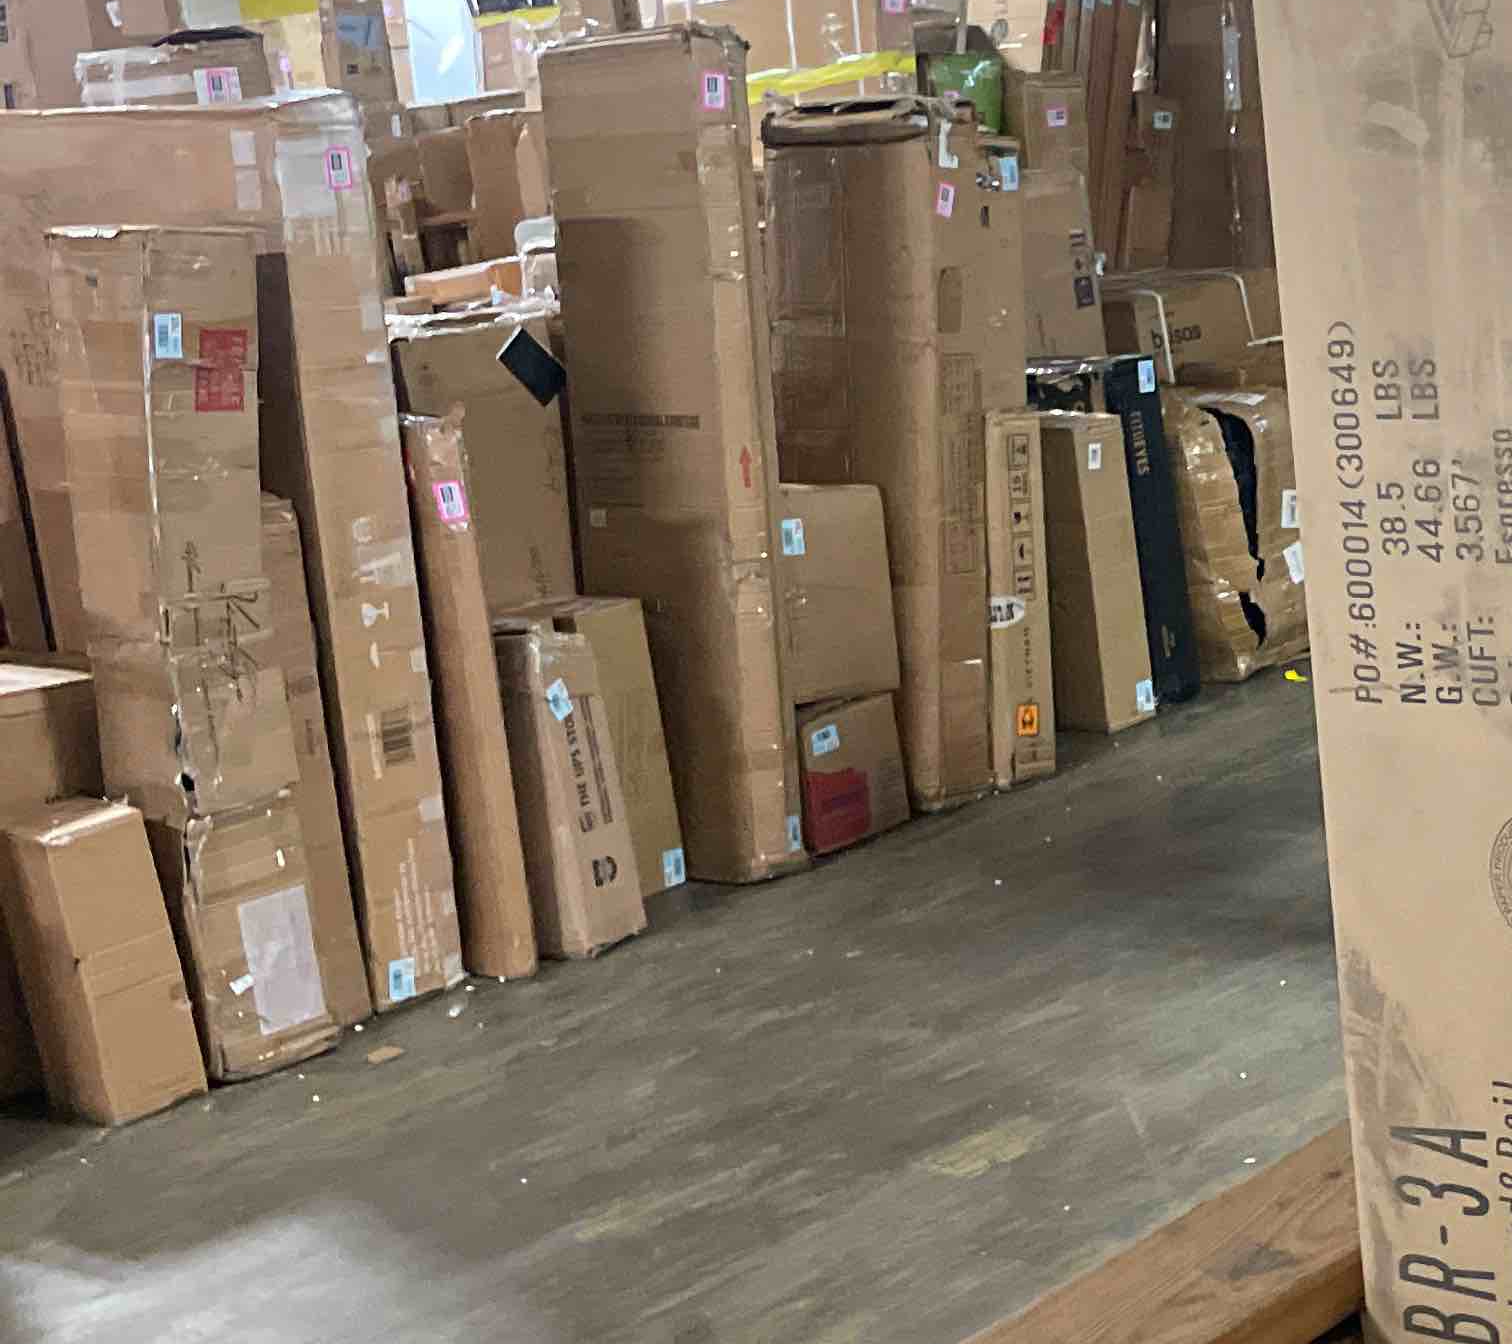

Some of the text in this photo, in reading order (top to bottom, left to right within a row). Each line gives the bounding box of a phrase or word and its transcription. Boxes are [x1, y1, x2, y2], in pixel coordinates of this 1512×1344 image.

[1371, 358, 1427, 706] N.W.: 38.5 LBS
[1408, 356, 1463, 706] G.W.: 44.66 LBS
[1466, 615, 1503, 708] CUFT:
